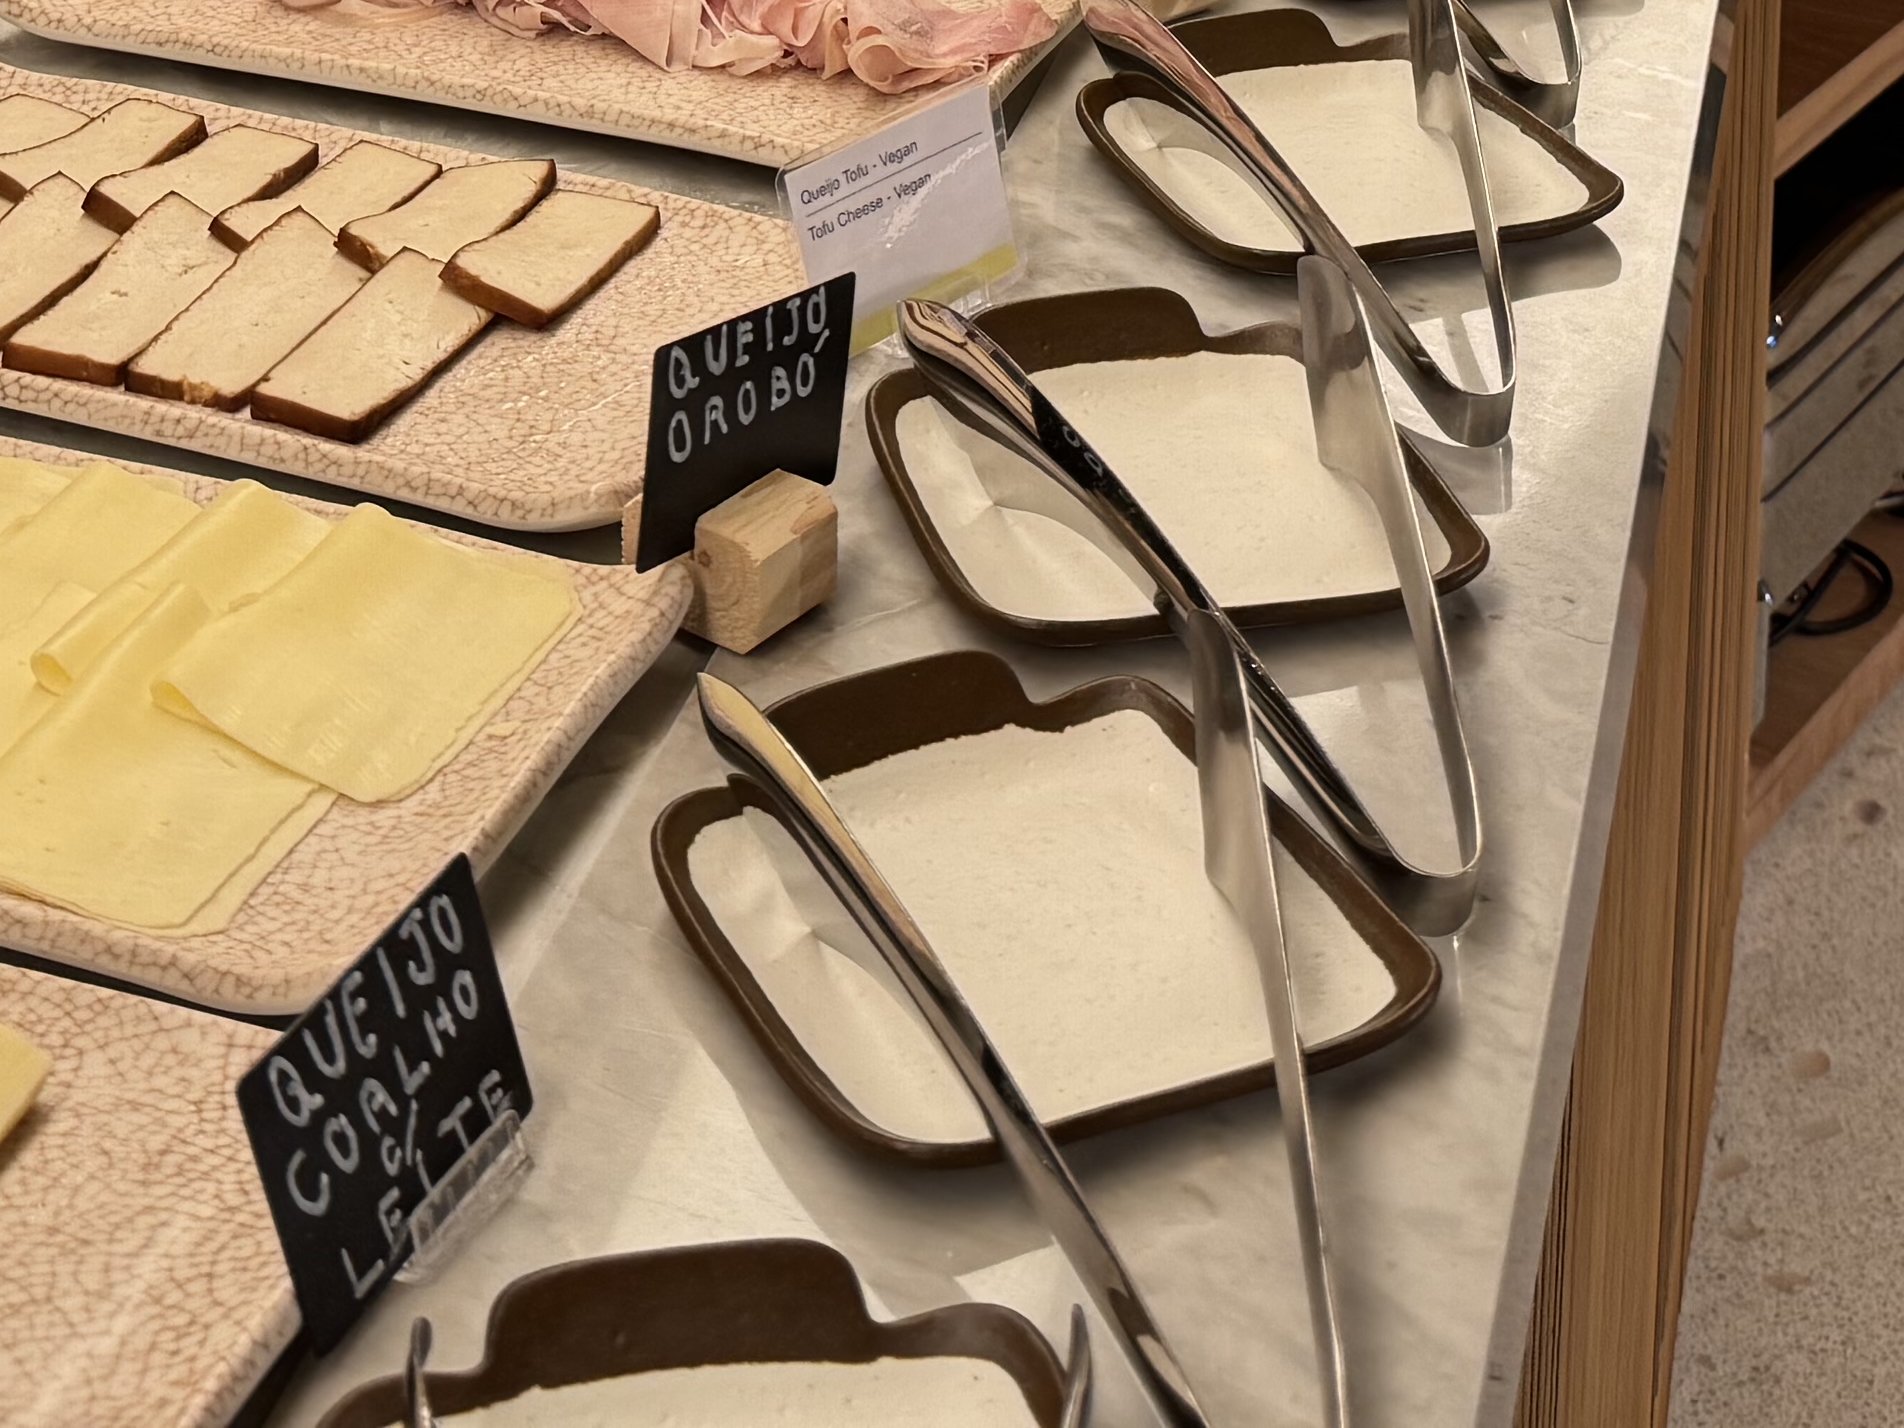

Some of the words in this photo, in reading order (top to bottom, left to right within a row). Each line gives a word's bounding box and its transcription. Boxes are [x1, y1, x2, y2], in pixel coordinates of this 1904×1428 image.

[800, 177, 842, 206] Queijo
[841, 162, 870, 186] Tofu
[878, 139, 919, 169] Vegan
[807, 218, 836, 242] Tofu
[837, 195, 884, 228] Cheese
[893, 172, 933, 200] Vegan
[668, 284, 828, 399] QUEIJO
[267, 892, 465, 1129] QUEIJO
[285, 968, 479, 1218] COALHO
[339, 1068, 516, 1300] LEITE
